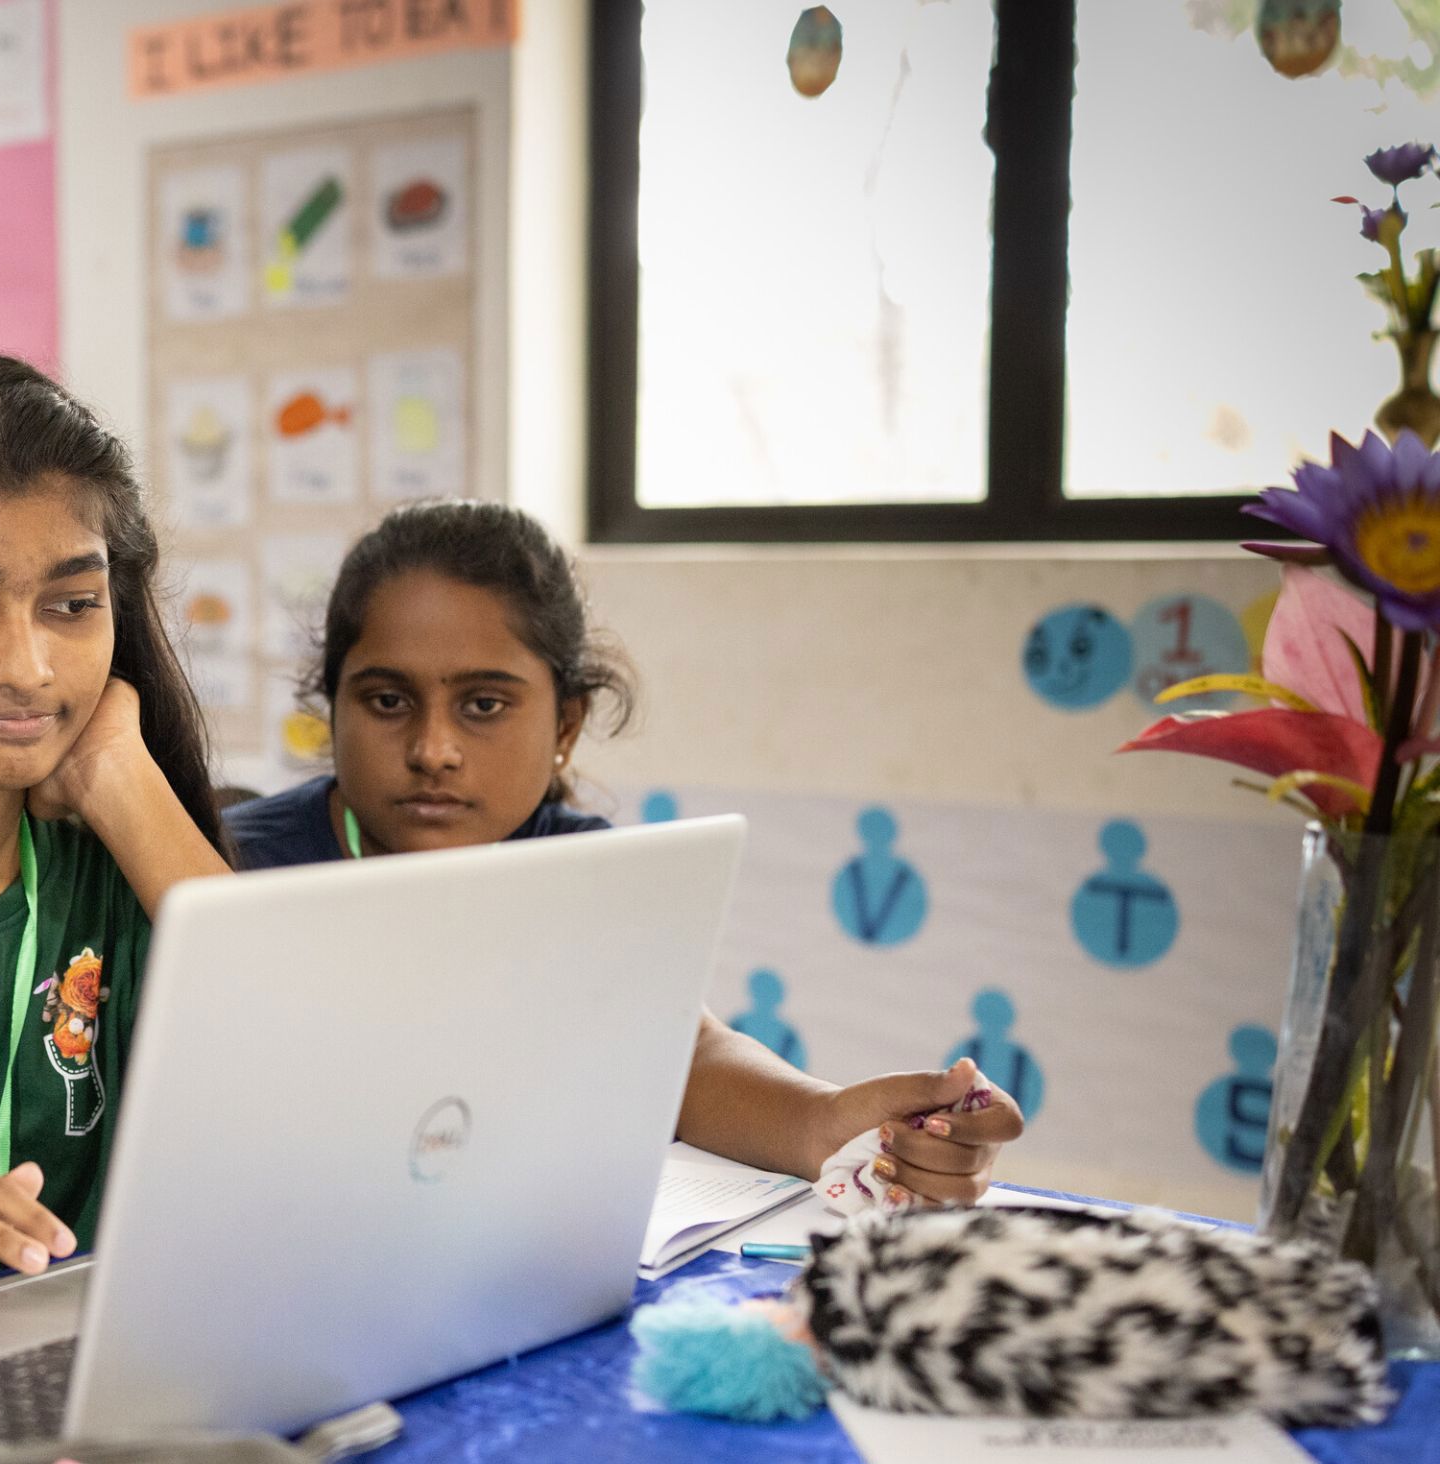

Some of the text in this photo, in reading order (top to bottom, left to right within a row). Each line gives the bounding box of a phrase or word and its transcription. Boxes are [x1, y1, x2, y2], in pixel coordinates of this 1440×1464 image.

[182, 4, 310, 81] LIKE
[1157, 600, 1204, 663] 1
[848, 856, 910, 943] V
[1085, 876, 1171, 958] T
